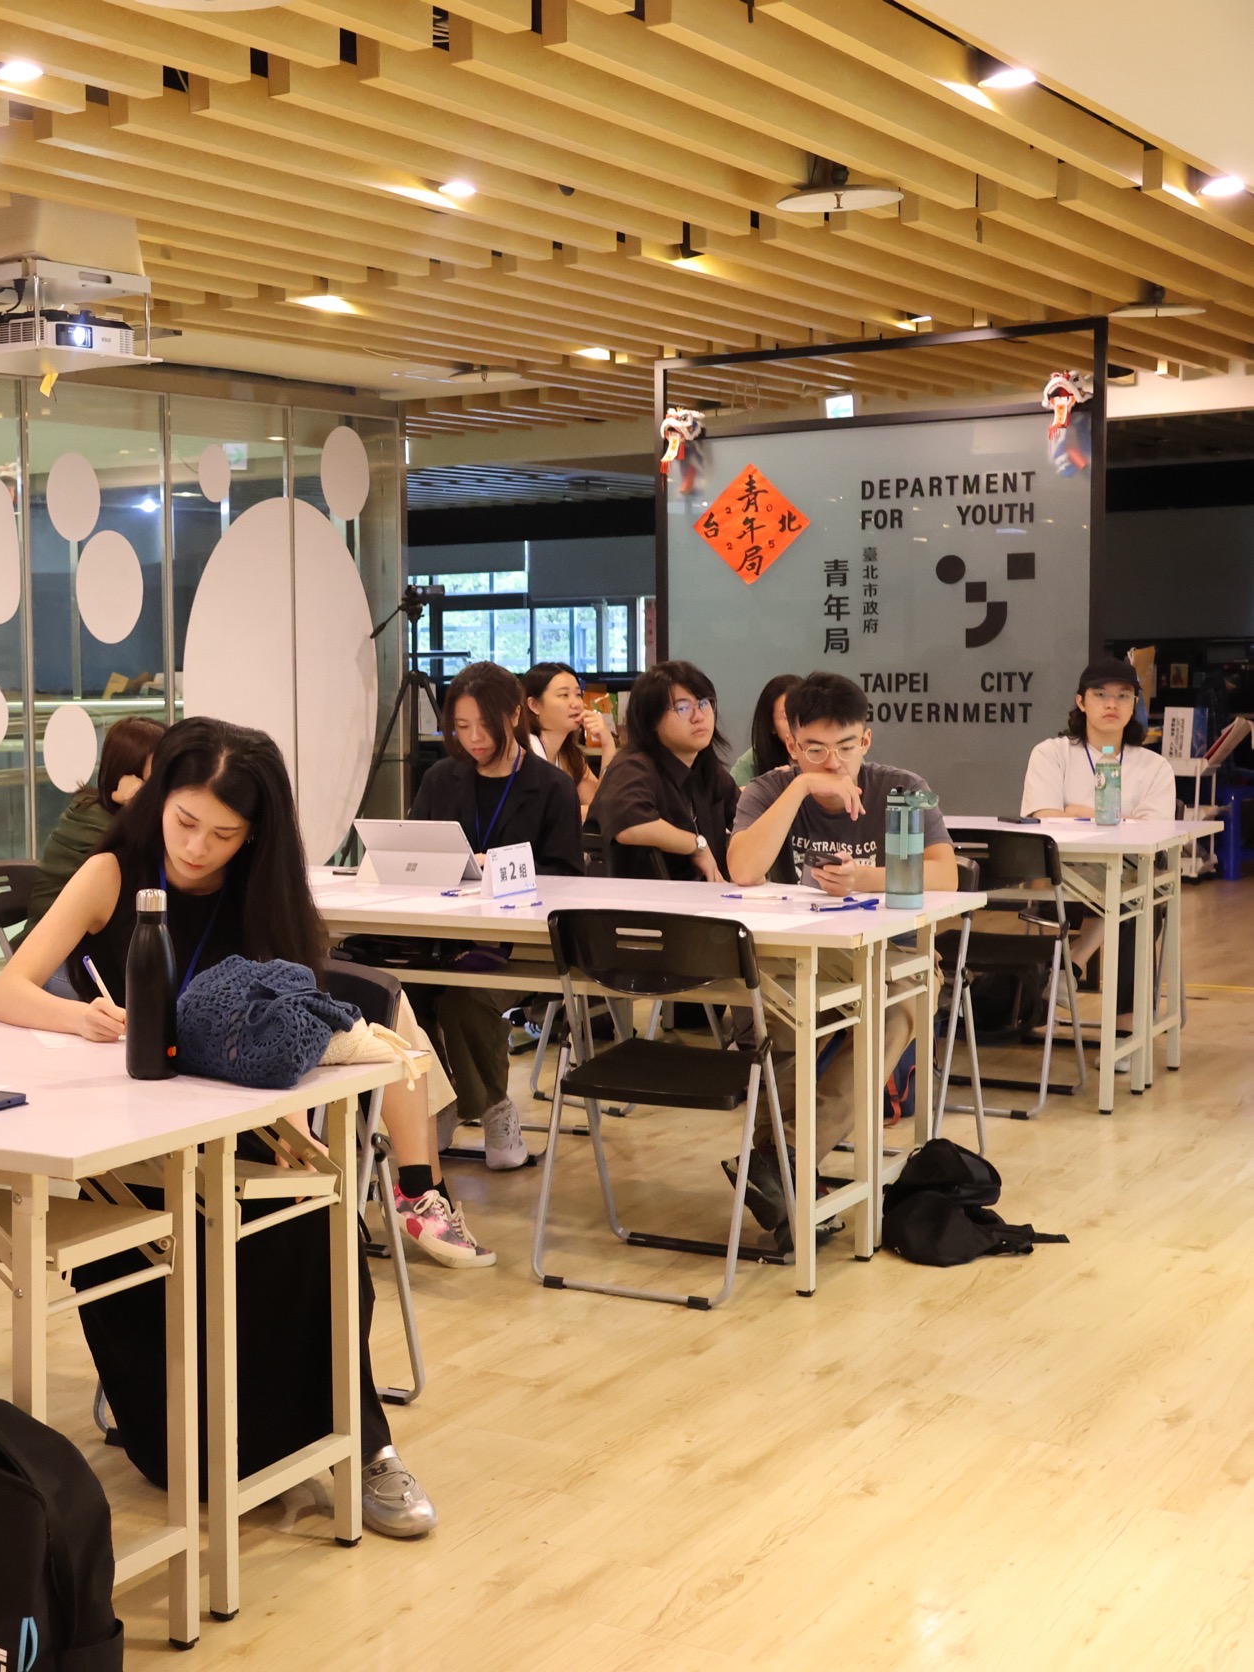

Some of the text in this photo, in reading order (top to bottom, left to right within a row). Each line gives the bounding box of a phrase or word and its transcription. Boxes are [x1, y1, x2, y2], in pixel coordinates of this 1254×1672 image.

[861, 471, 1035, 500] DEPARTMENT
[861, 503, 1034, 530] FOR YOUTH
[769, 540, 774, 548] 5
[863, 547, 878, 633] 臺北市政府
[824, 559, 850, 654] 青年局
[860, 672, 1033, 693] TAIPEI CITY
[792, 836, 811, 849] LEV
[812, 841, 853, 855] STRAUSS
[856, 844, 862, 855] &
[500, 861, 527, 882] 第2組
